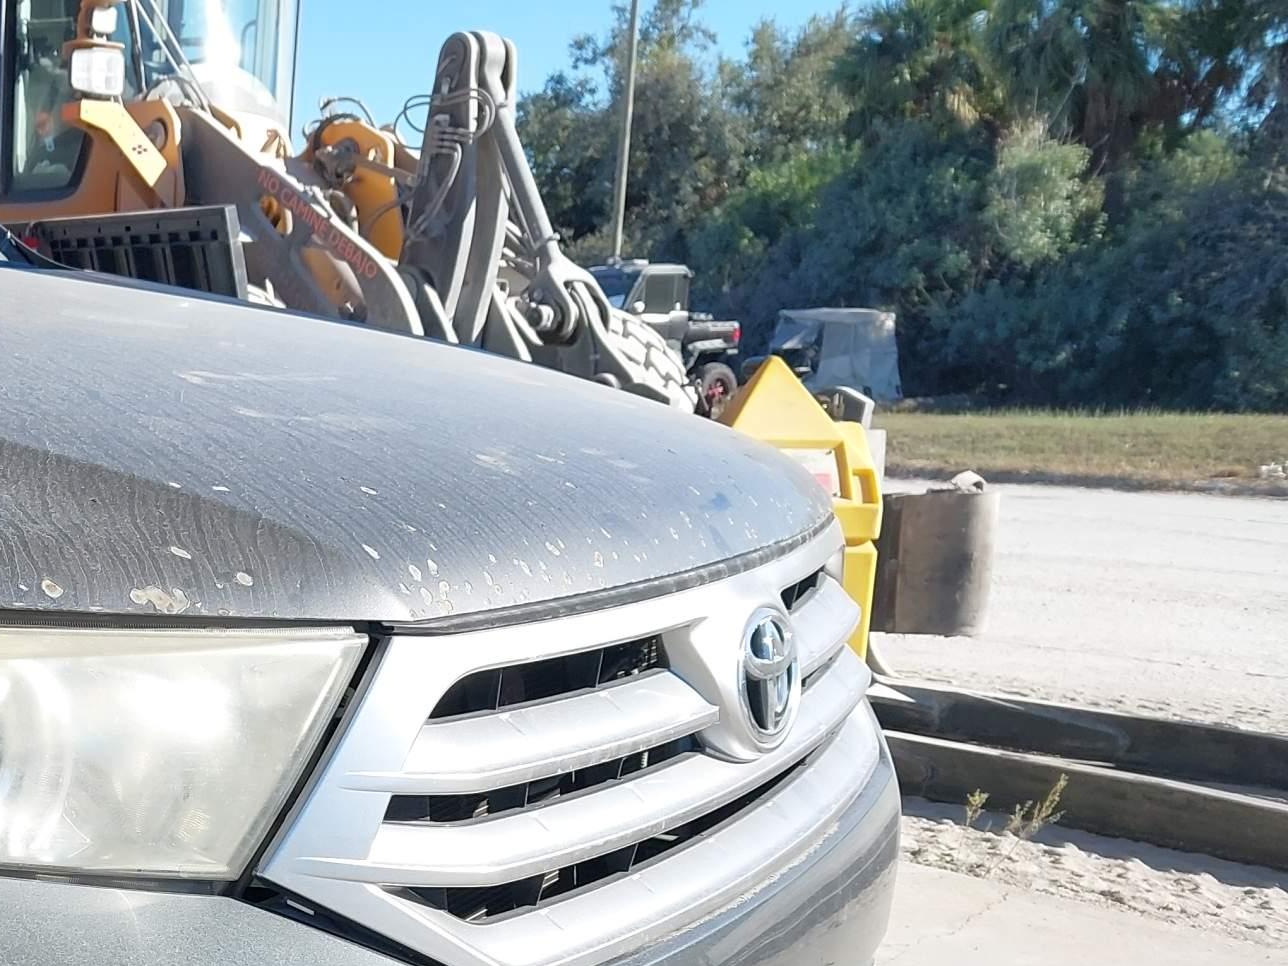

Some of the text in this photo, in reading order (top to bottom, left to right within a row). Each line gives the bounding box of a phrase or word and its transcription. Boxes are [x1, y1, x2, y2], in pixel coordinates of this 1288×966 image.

[256, 168, 378, 279] NO CAMINE DEBAJO
